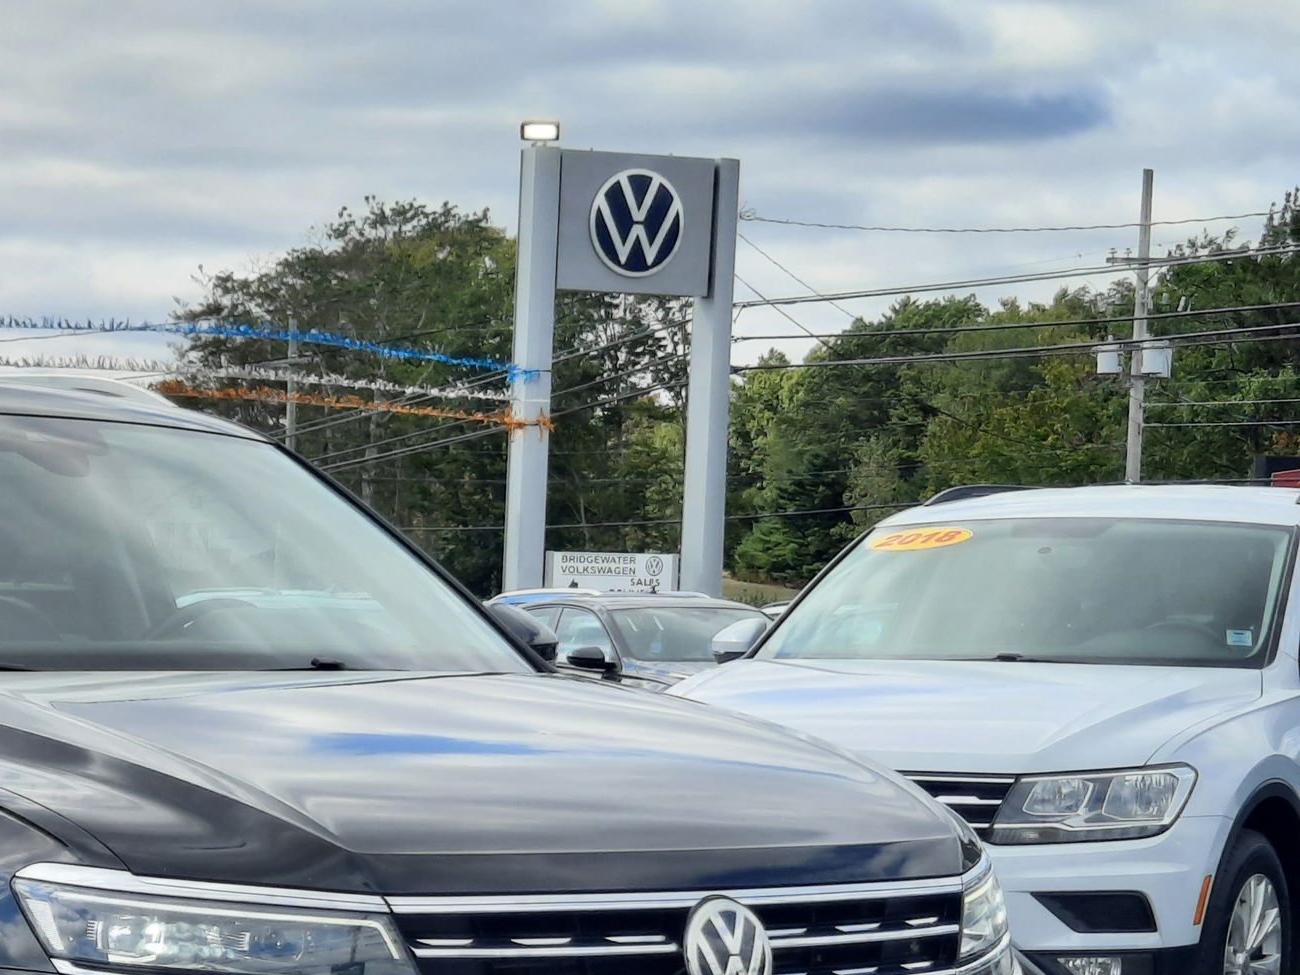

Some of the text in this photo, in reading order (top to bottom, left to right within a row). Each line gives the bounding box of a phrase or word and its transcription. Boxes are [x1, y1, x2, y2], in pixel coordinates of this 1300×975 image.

[590, 169, 684, 277] VW
[874, 530, 962, 548] 2018
[561, 555, 636, 564] BRIDGEWATER
[561, 565, 636, 575] VOLKSWAGEN
